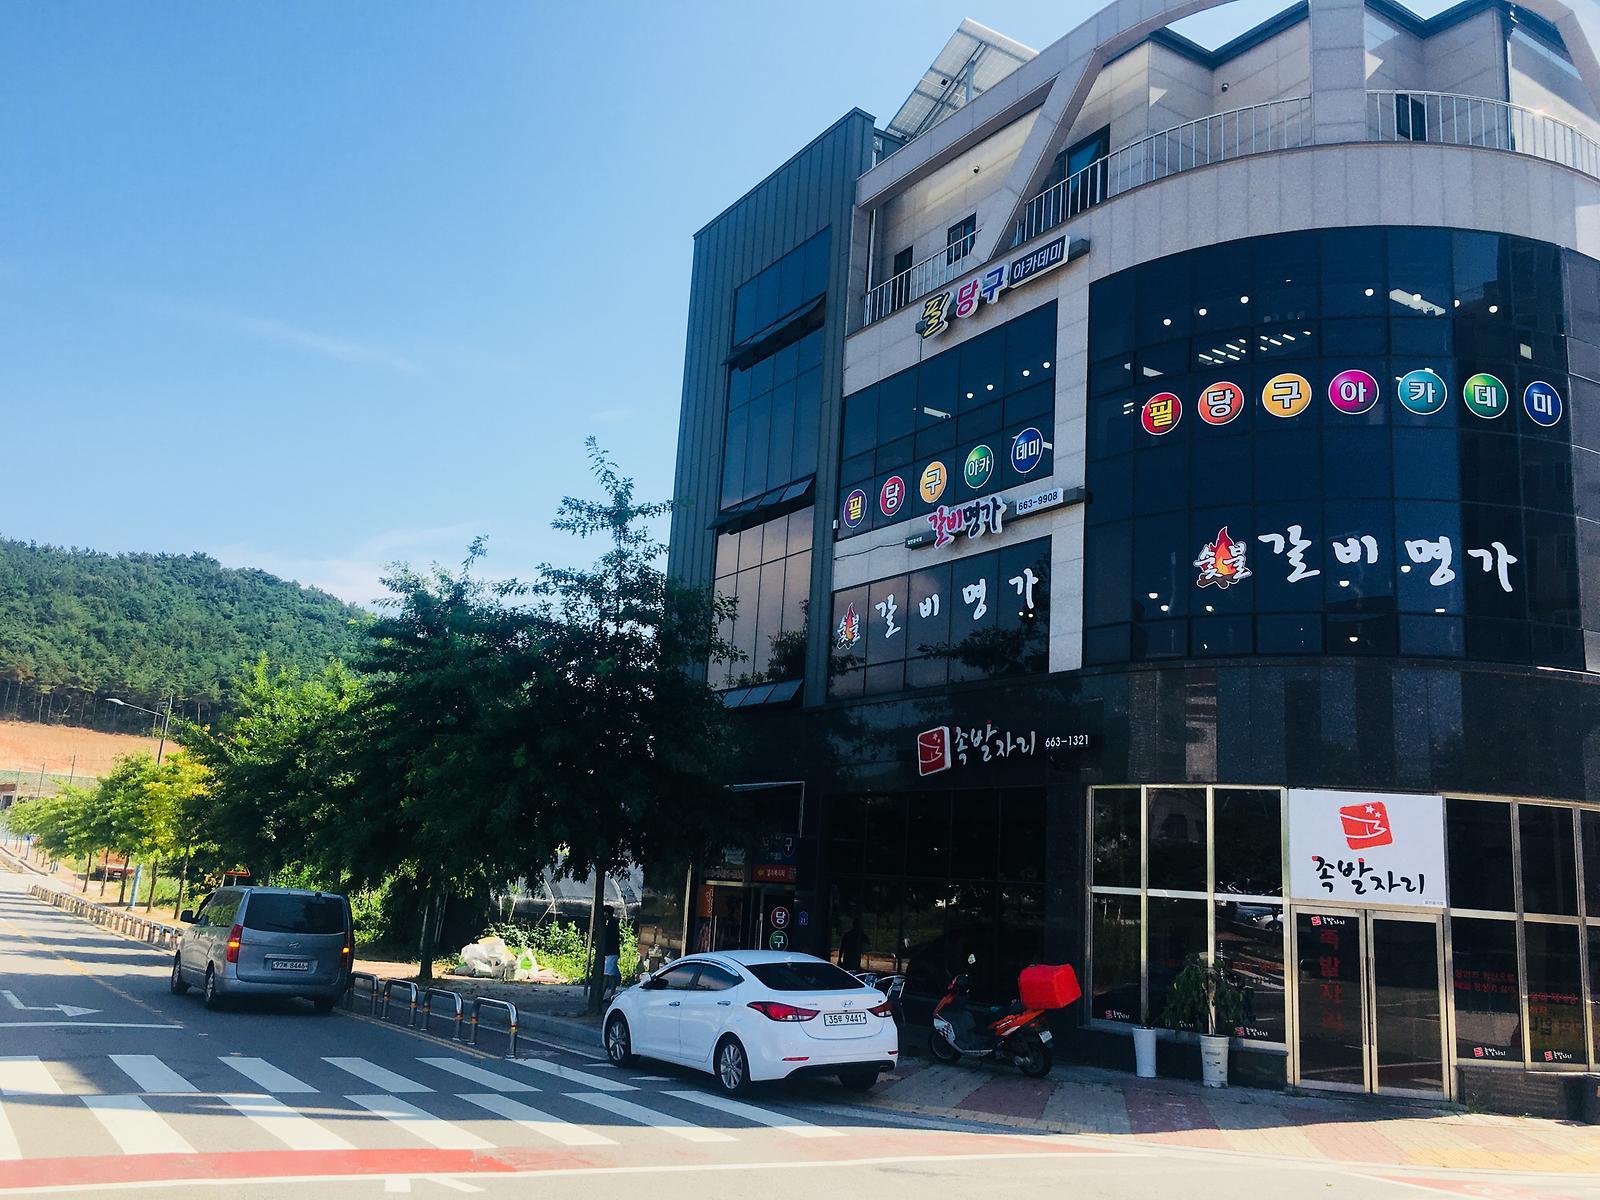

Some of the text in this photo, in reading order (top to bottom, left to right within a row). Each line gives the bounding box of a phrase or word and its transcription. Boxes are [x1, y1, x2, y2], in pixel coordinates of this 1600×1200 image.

[922, 242, 1063, 338] 필당구 아카데미
[928, 491, 1058, 548] 갈비명가 663-9908
[1194, 525, 1518, 592] 숯불 갈비명가
[837, 568, 1039, 642] 숯불 갈비명가
[954, 720, 1089, 765] 족발자리 663-1321
[1311, 855, 1426, 895] 족발자리
[845, 1014, 862, 1023] 9441
